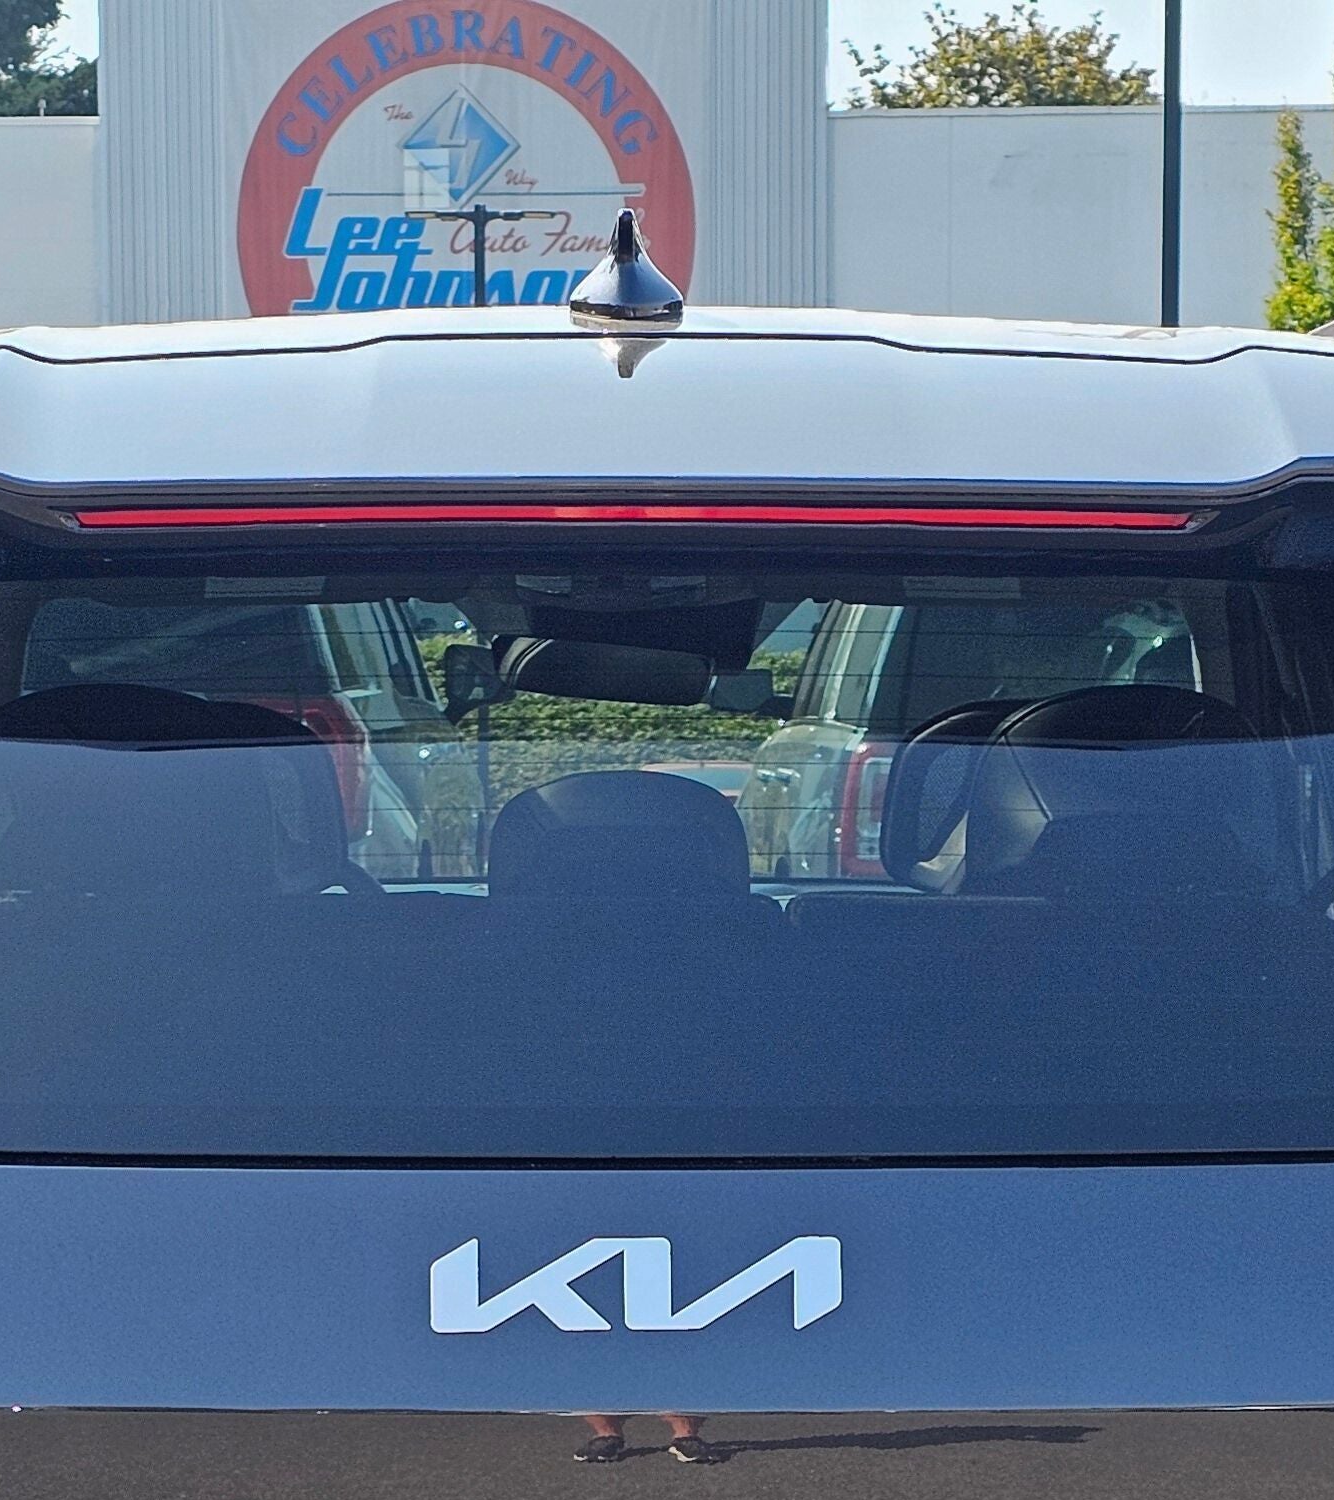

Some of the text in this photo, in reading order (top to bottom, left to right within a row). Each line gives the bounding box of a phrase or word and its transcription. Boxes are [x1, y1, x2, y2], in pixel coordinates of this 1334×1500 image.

[275, 8, 658, 158] CELEBRATING
[383, 103, 414, 122] The
[504, 168, 539, 192] Way
[283, 187, 434, 257] Lee
[430, 1236, 843, 1334] KIA
